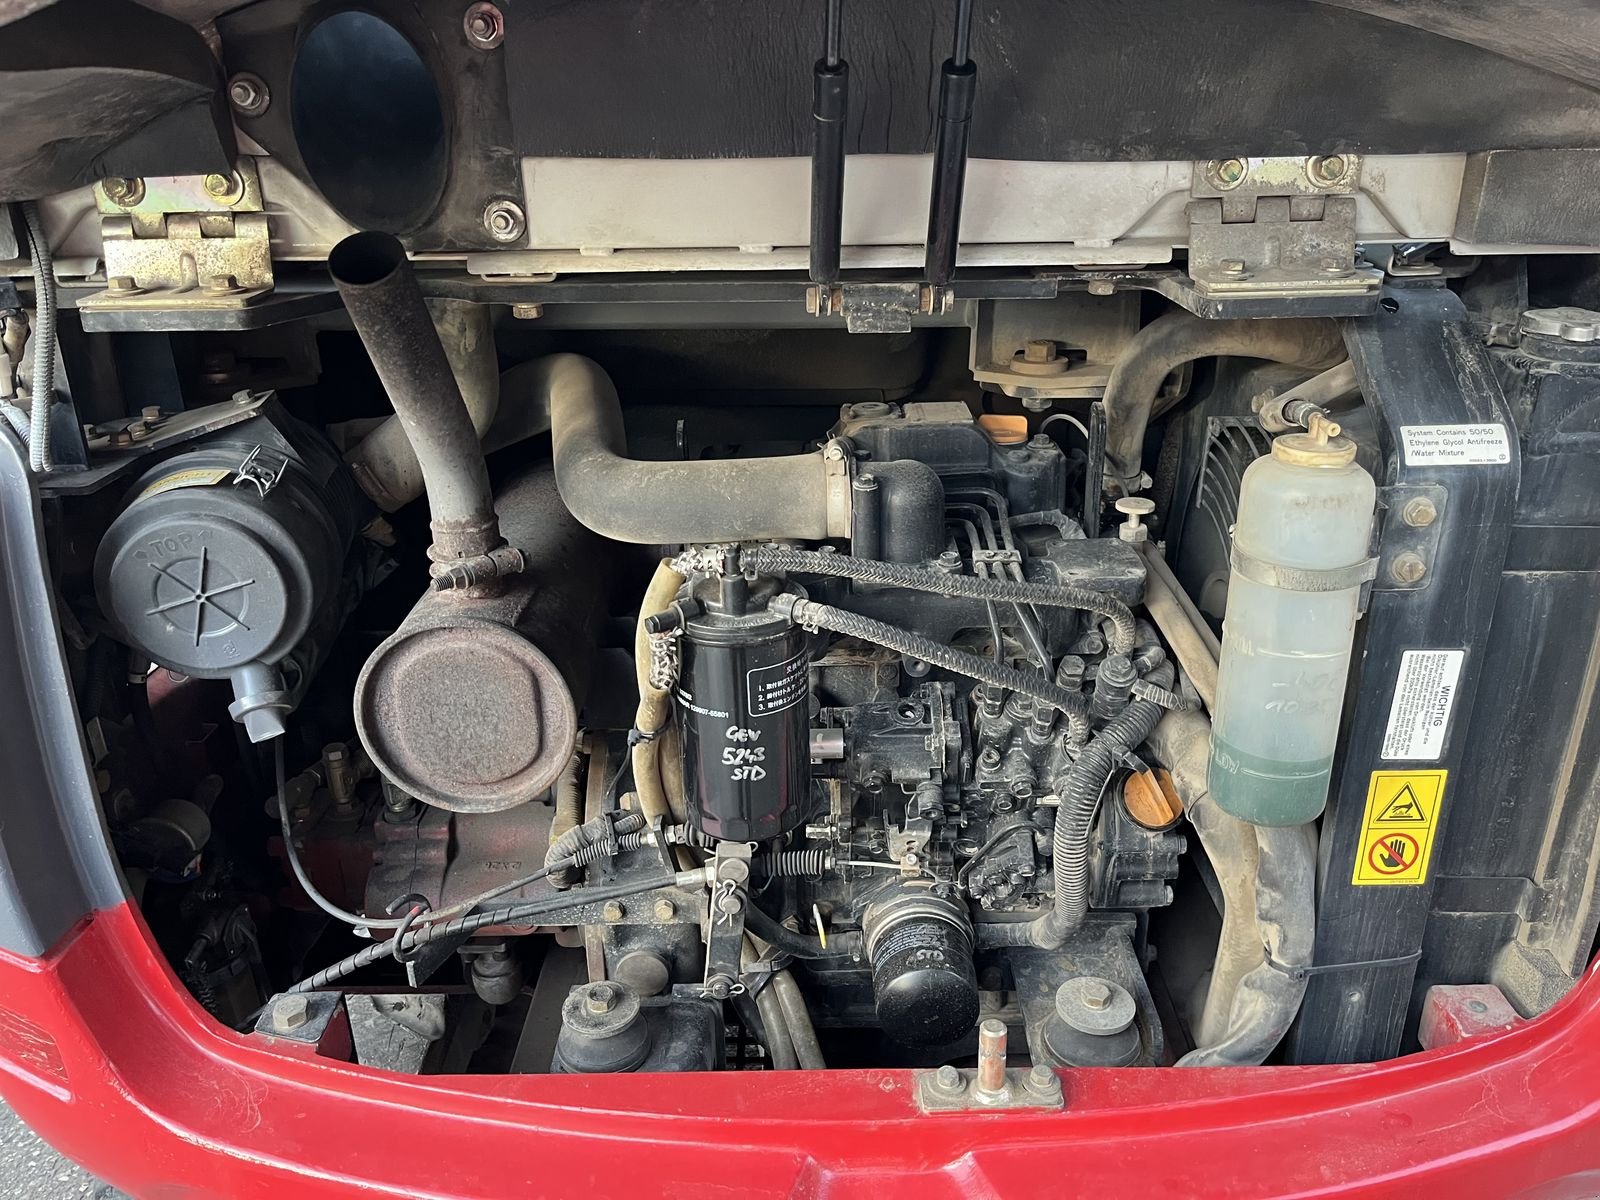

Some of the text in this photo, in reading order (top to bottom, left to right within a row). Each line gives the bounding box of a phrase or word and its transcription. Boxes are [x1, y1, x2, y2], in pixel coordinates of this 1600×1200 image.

[1407, 429, 1434, 438] System
[1409, 439, 1440, 447] Ethylene
[1442, 438, 1464, 447] Glycol
[149, 530, 193, 557] TOP
[1433, 686, 1450, 726] WICHTIG
[721, 747, 766, 765] 5243
[730, 765, 767, 782] STD
[916, 949, 944, 961] STD
